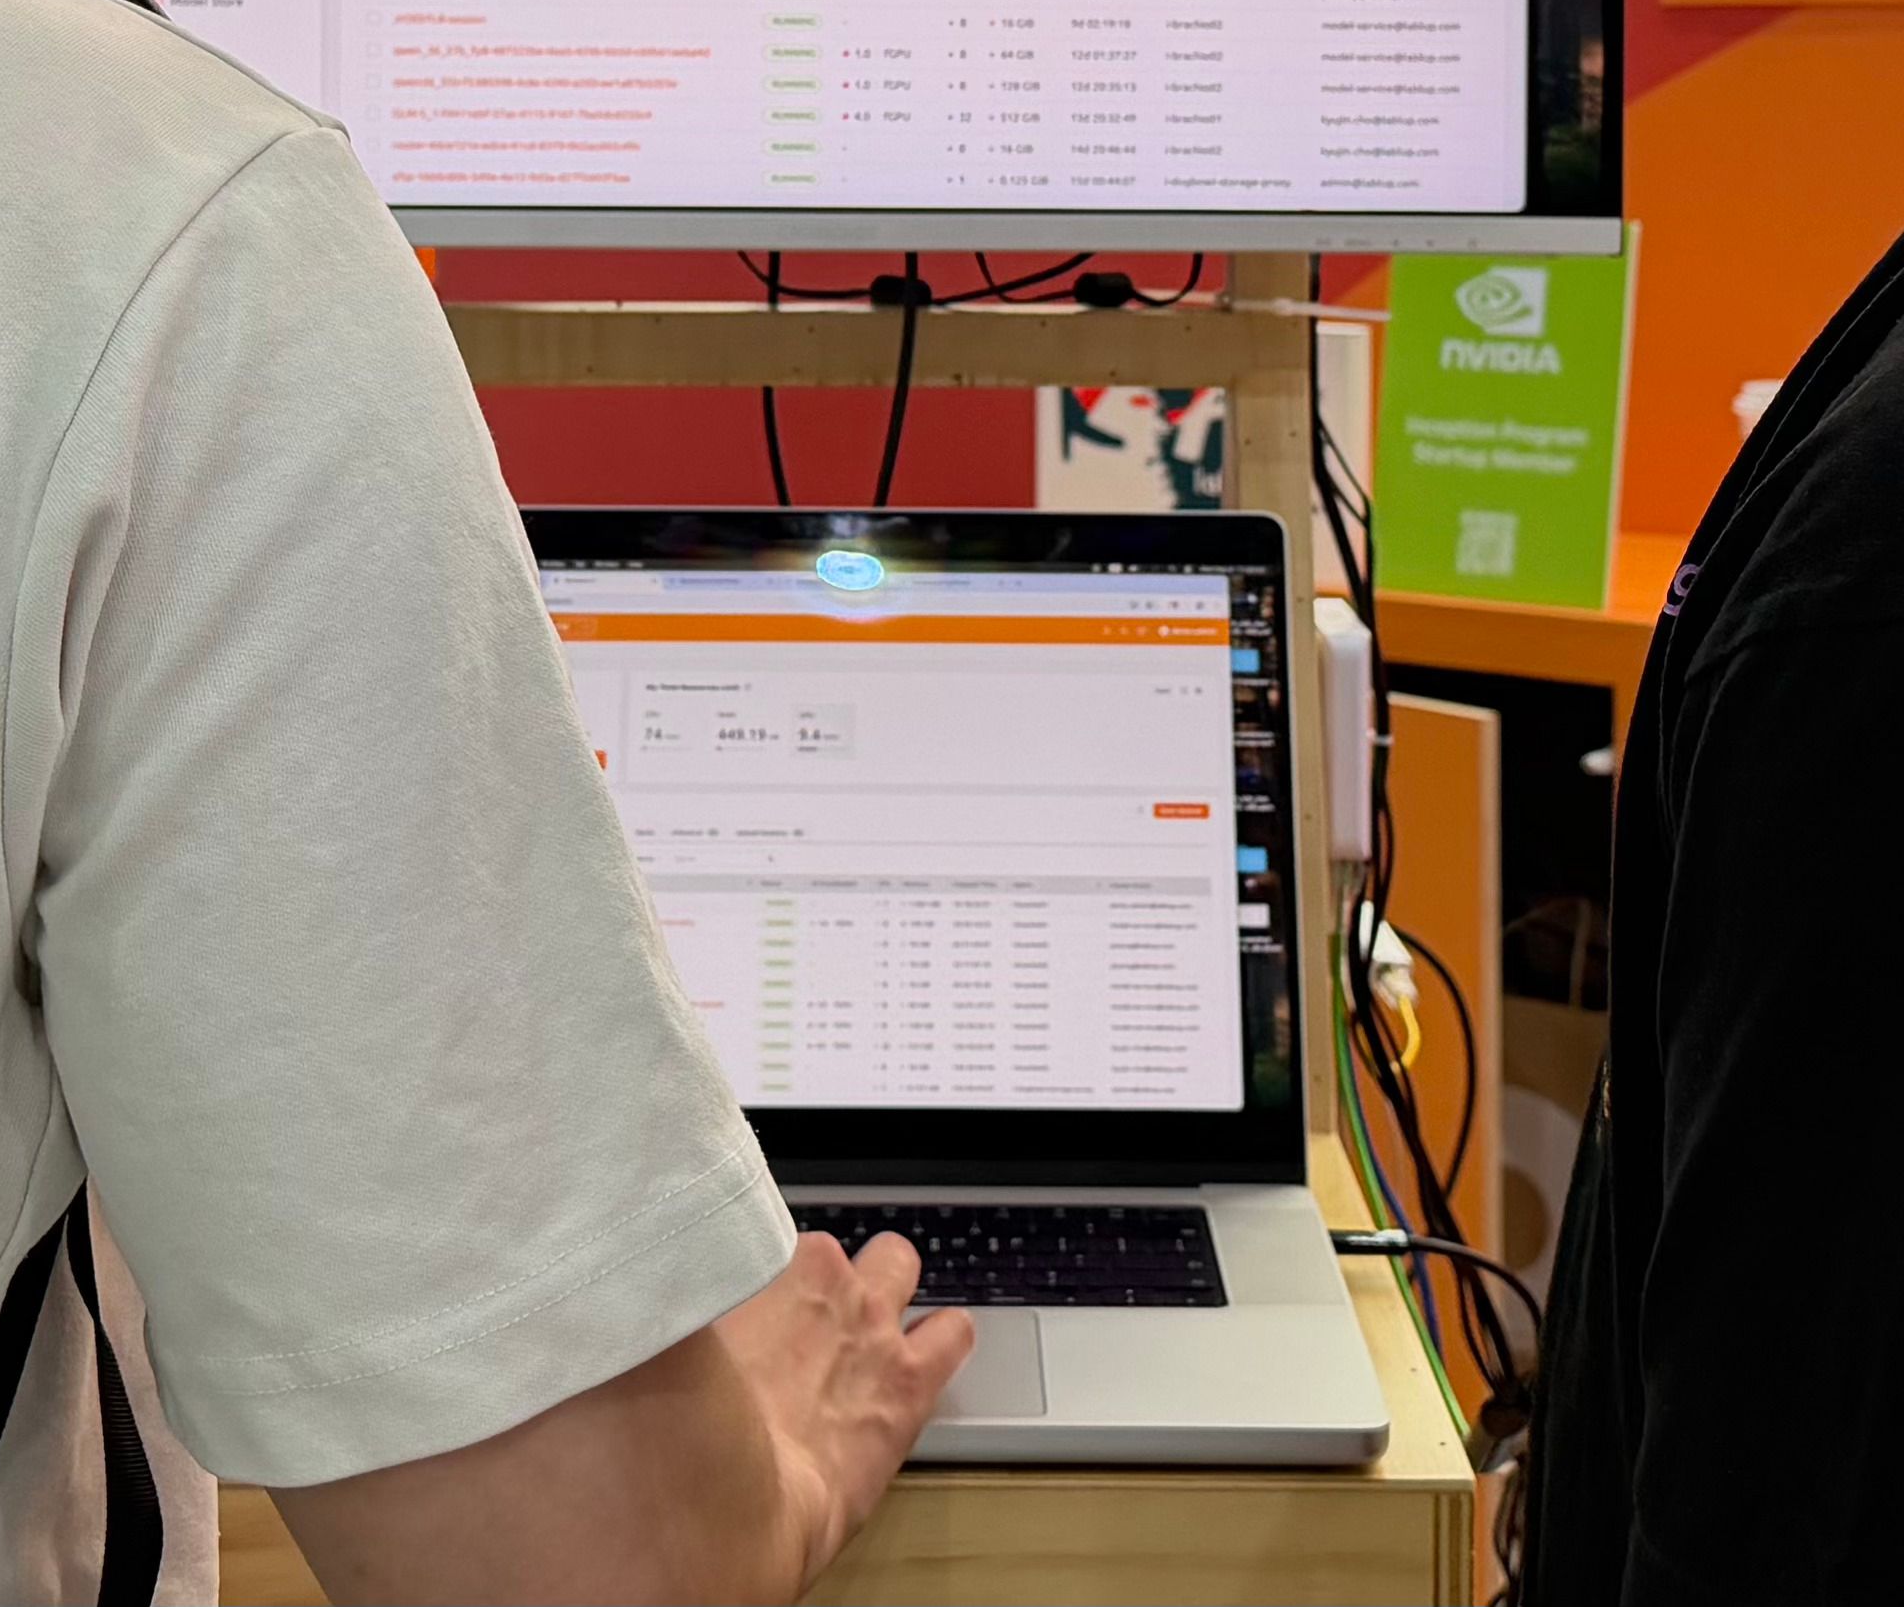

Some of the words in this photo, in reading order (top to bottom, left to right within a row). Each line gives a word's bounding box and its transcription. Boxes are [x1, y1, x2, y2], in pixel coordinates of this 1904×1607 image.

[1439, 338, 1562, 375] NVIDIA
[1405, 417, 1495, 441] Inception
[1499, 417, 1590, 447] Program
[1491, 448, 1578, 473] Member
